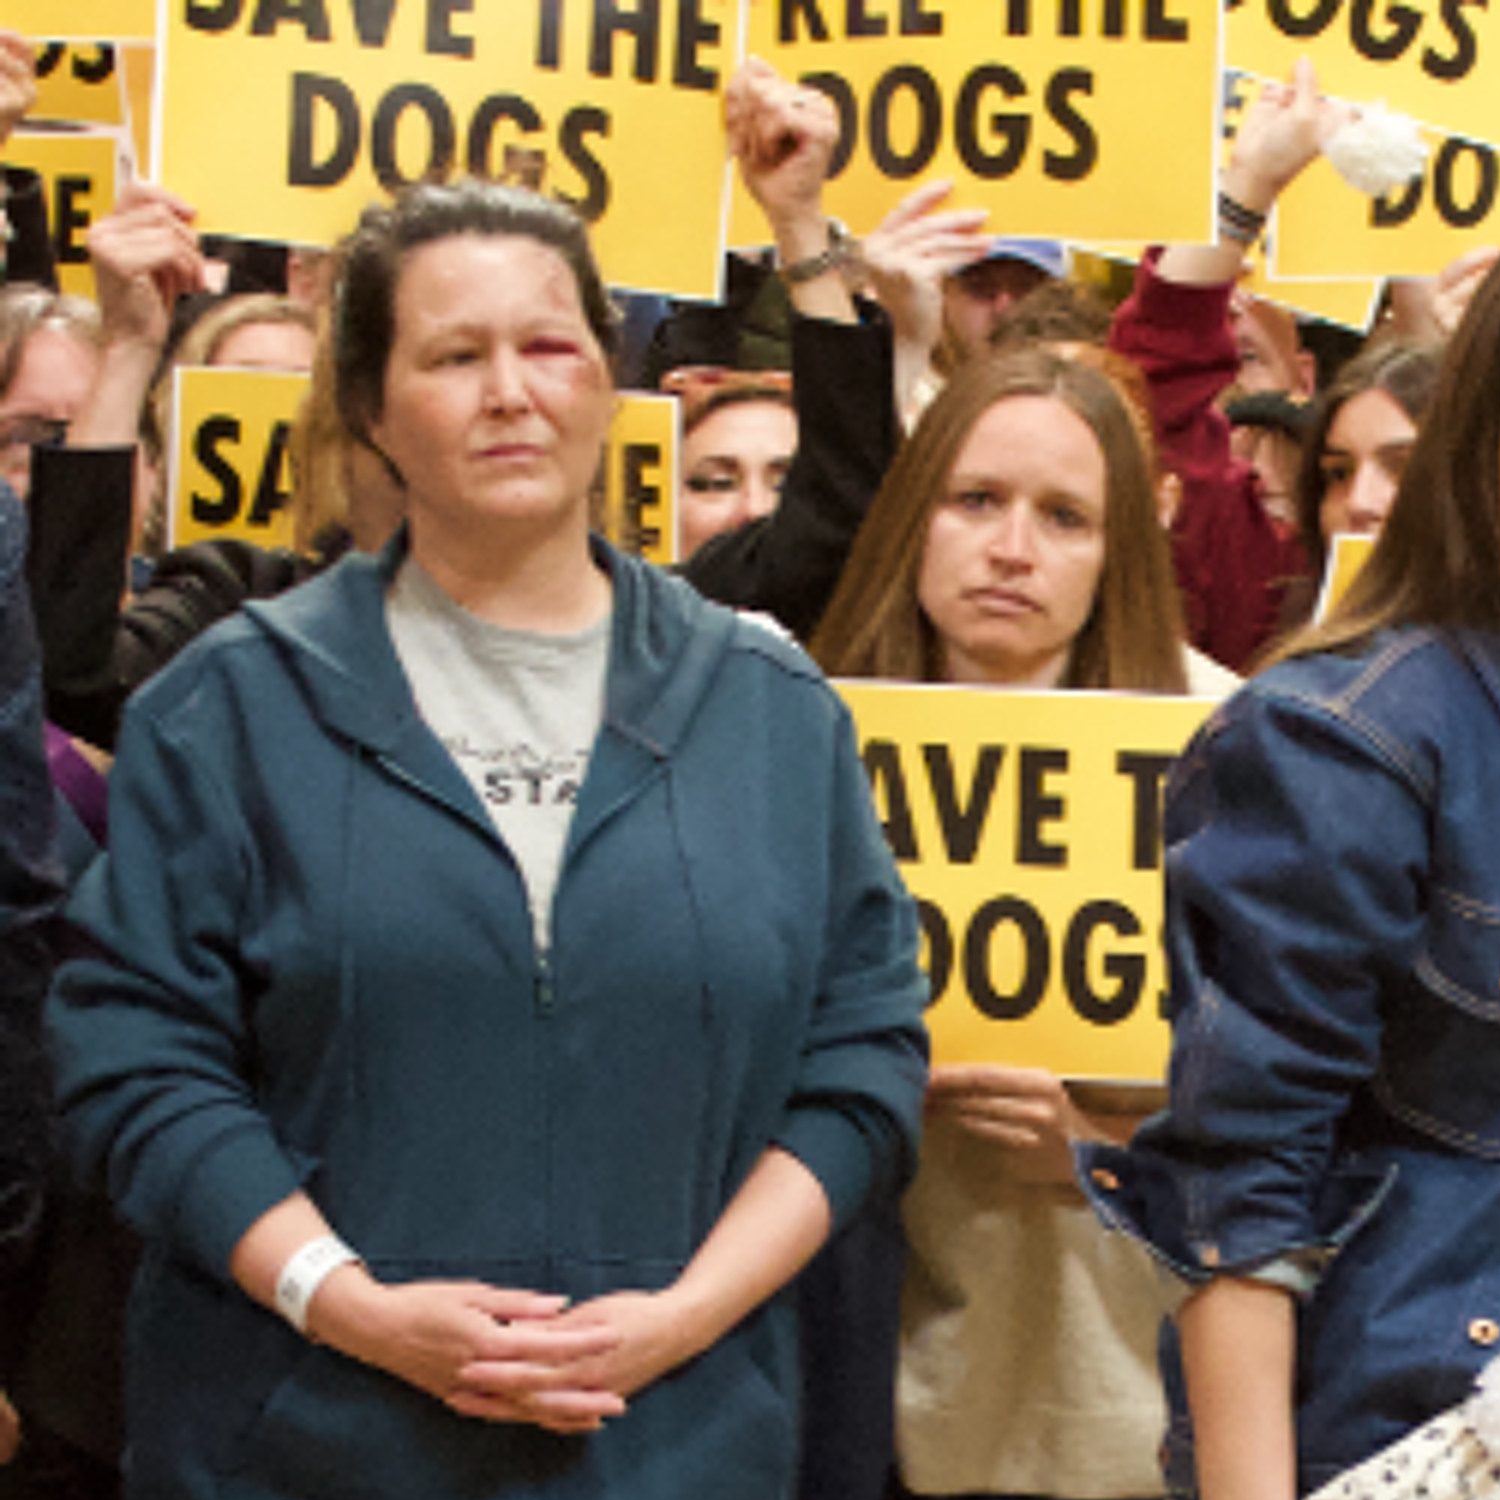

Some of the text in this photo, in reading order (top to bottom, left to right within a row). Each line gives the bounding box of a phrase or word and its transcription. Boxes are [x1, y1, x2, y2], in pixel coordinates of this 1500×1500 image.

[288, 72, 611, 224] DOGS
[191, 415, 294, 528] SA
[862, 739, 1070, 871] AVE
